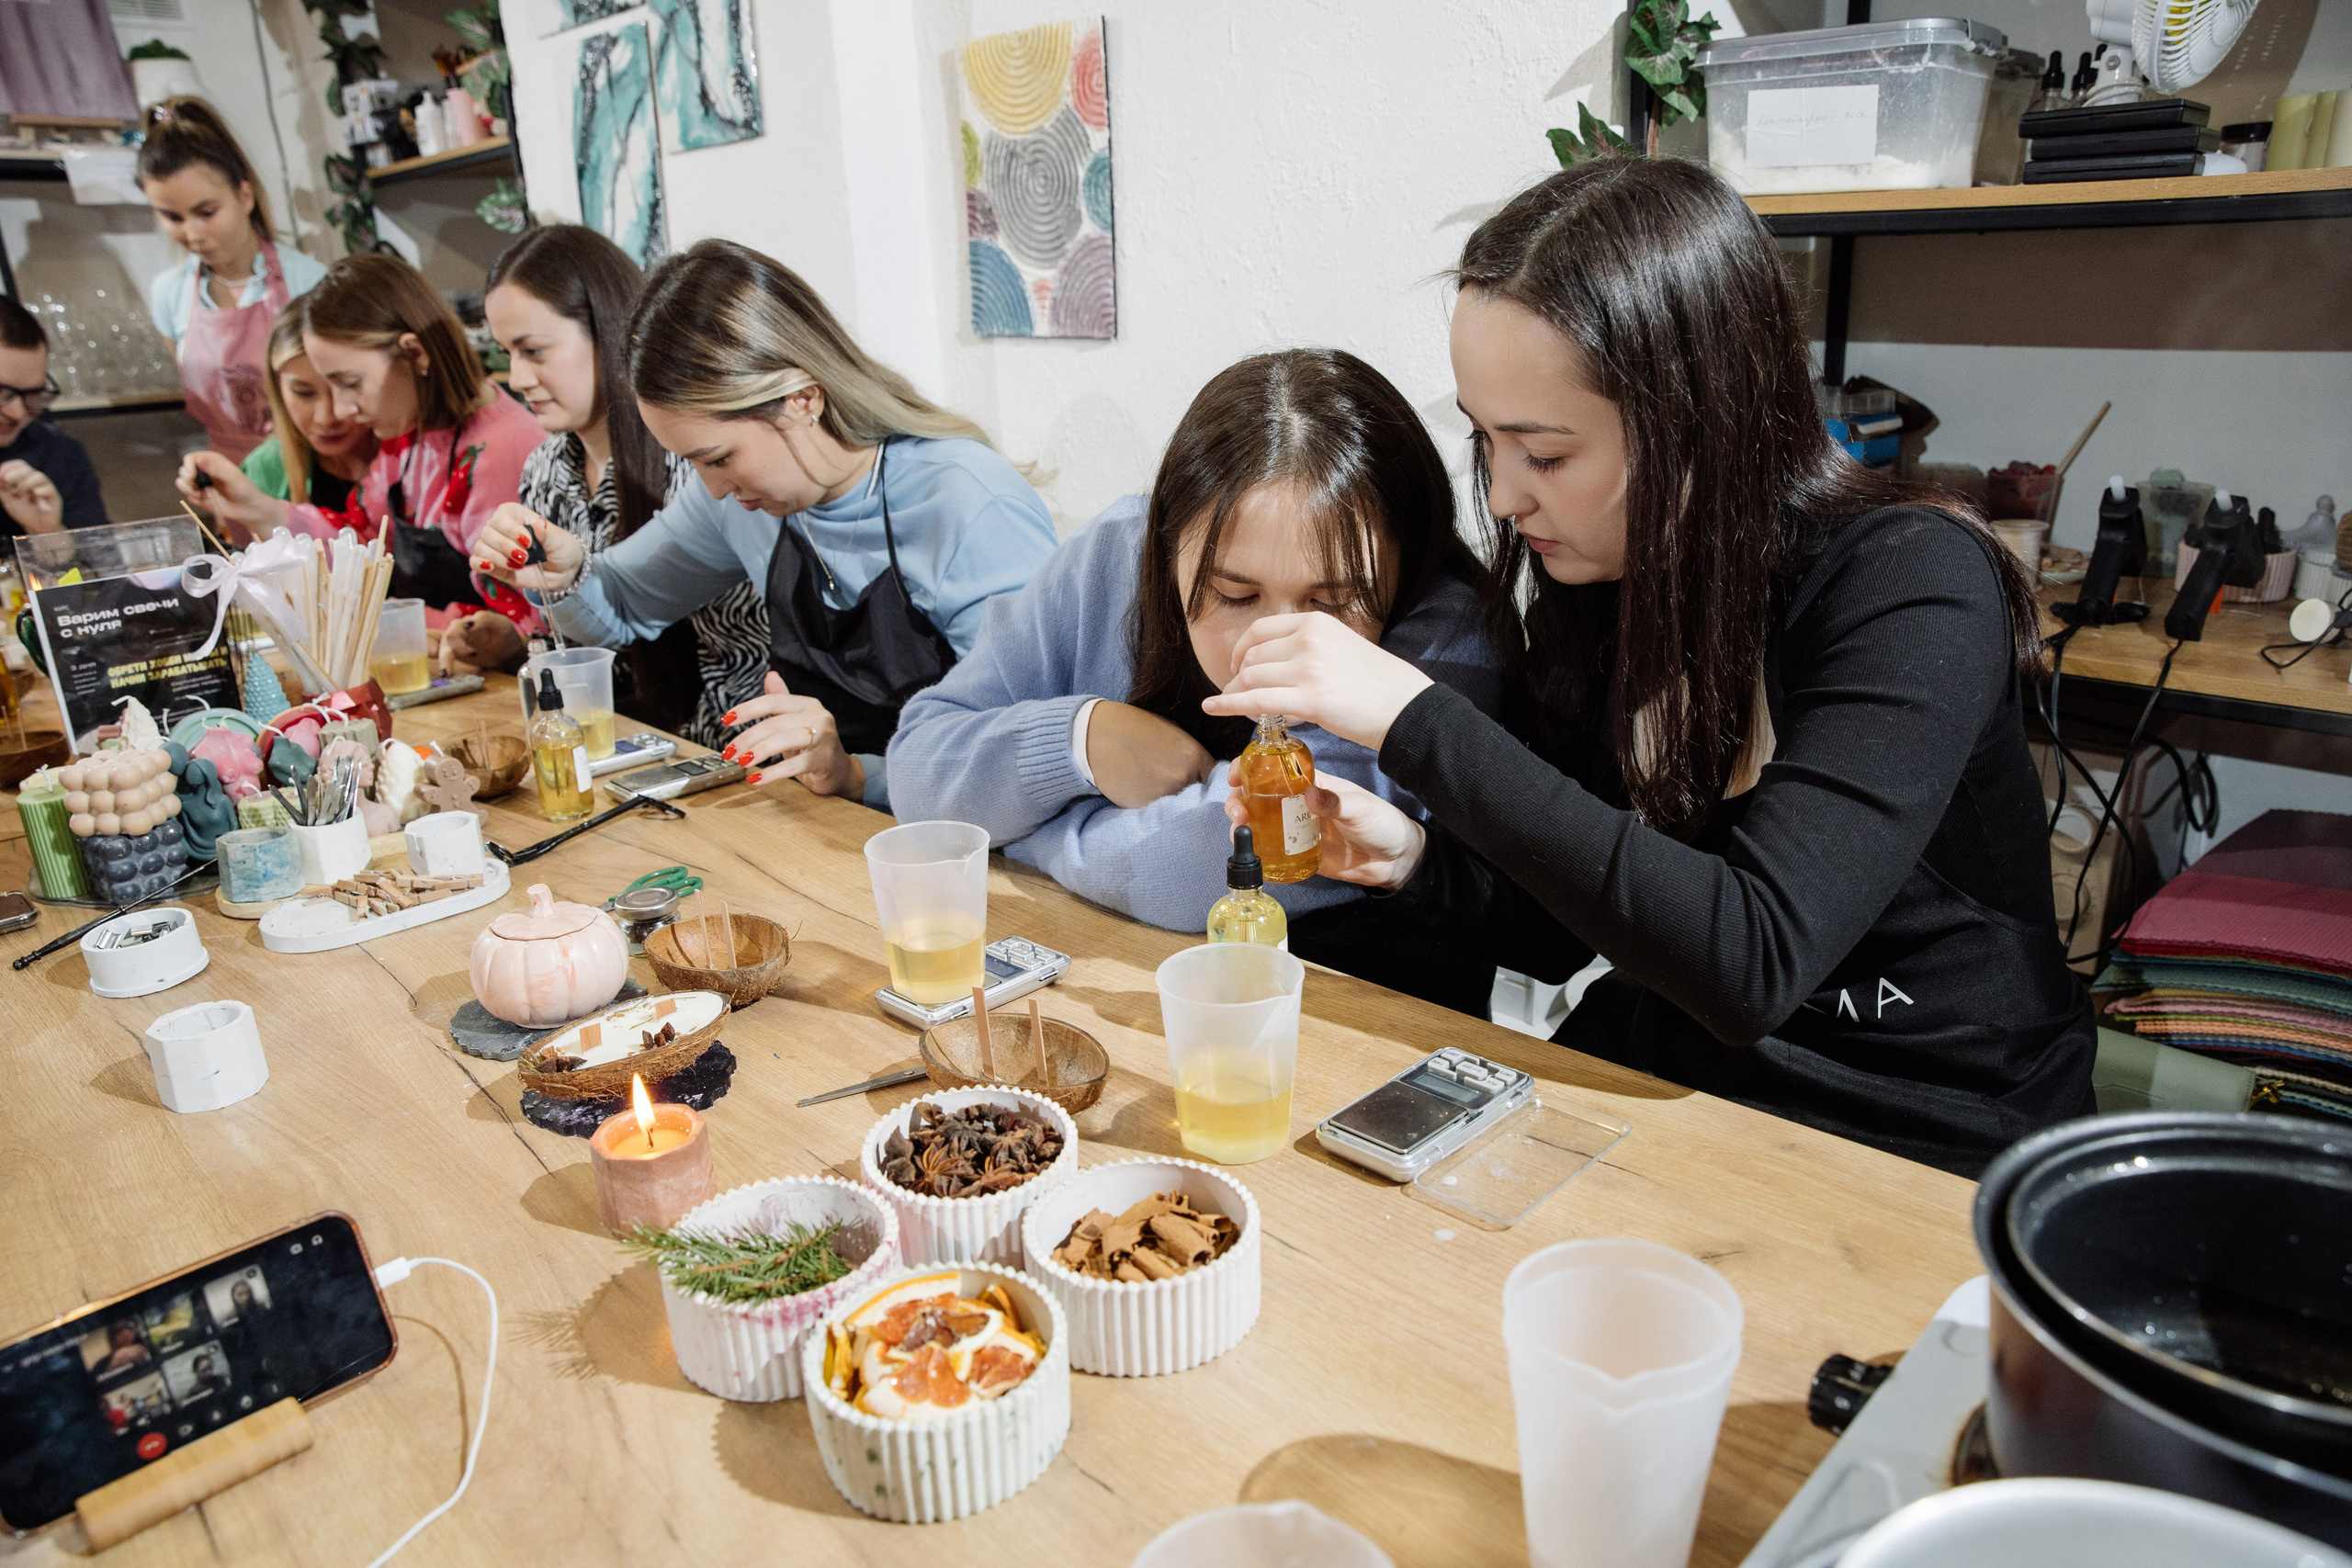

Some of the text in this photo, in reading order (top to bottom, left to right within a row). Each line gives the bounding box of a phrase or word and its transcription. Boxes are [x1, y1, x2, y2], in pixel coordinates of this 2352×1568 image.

[57, 598, 179, 626] Варим свечи
[60, 620, 122, 638] с нуля
[107, 661, 148, 677] ОБРЕТИ
[110, 673, 147, 689] НАЧНИ
